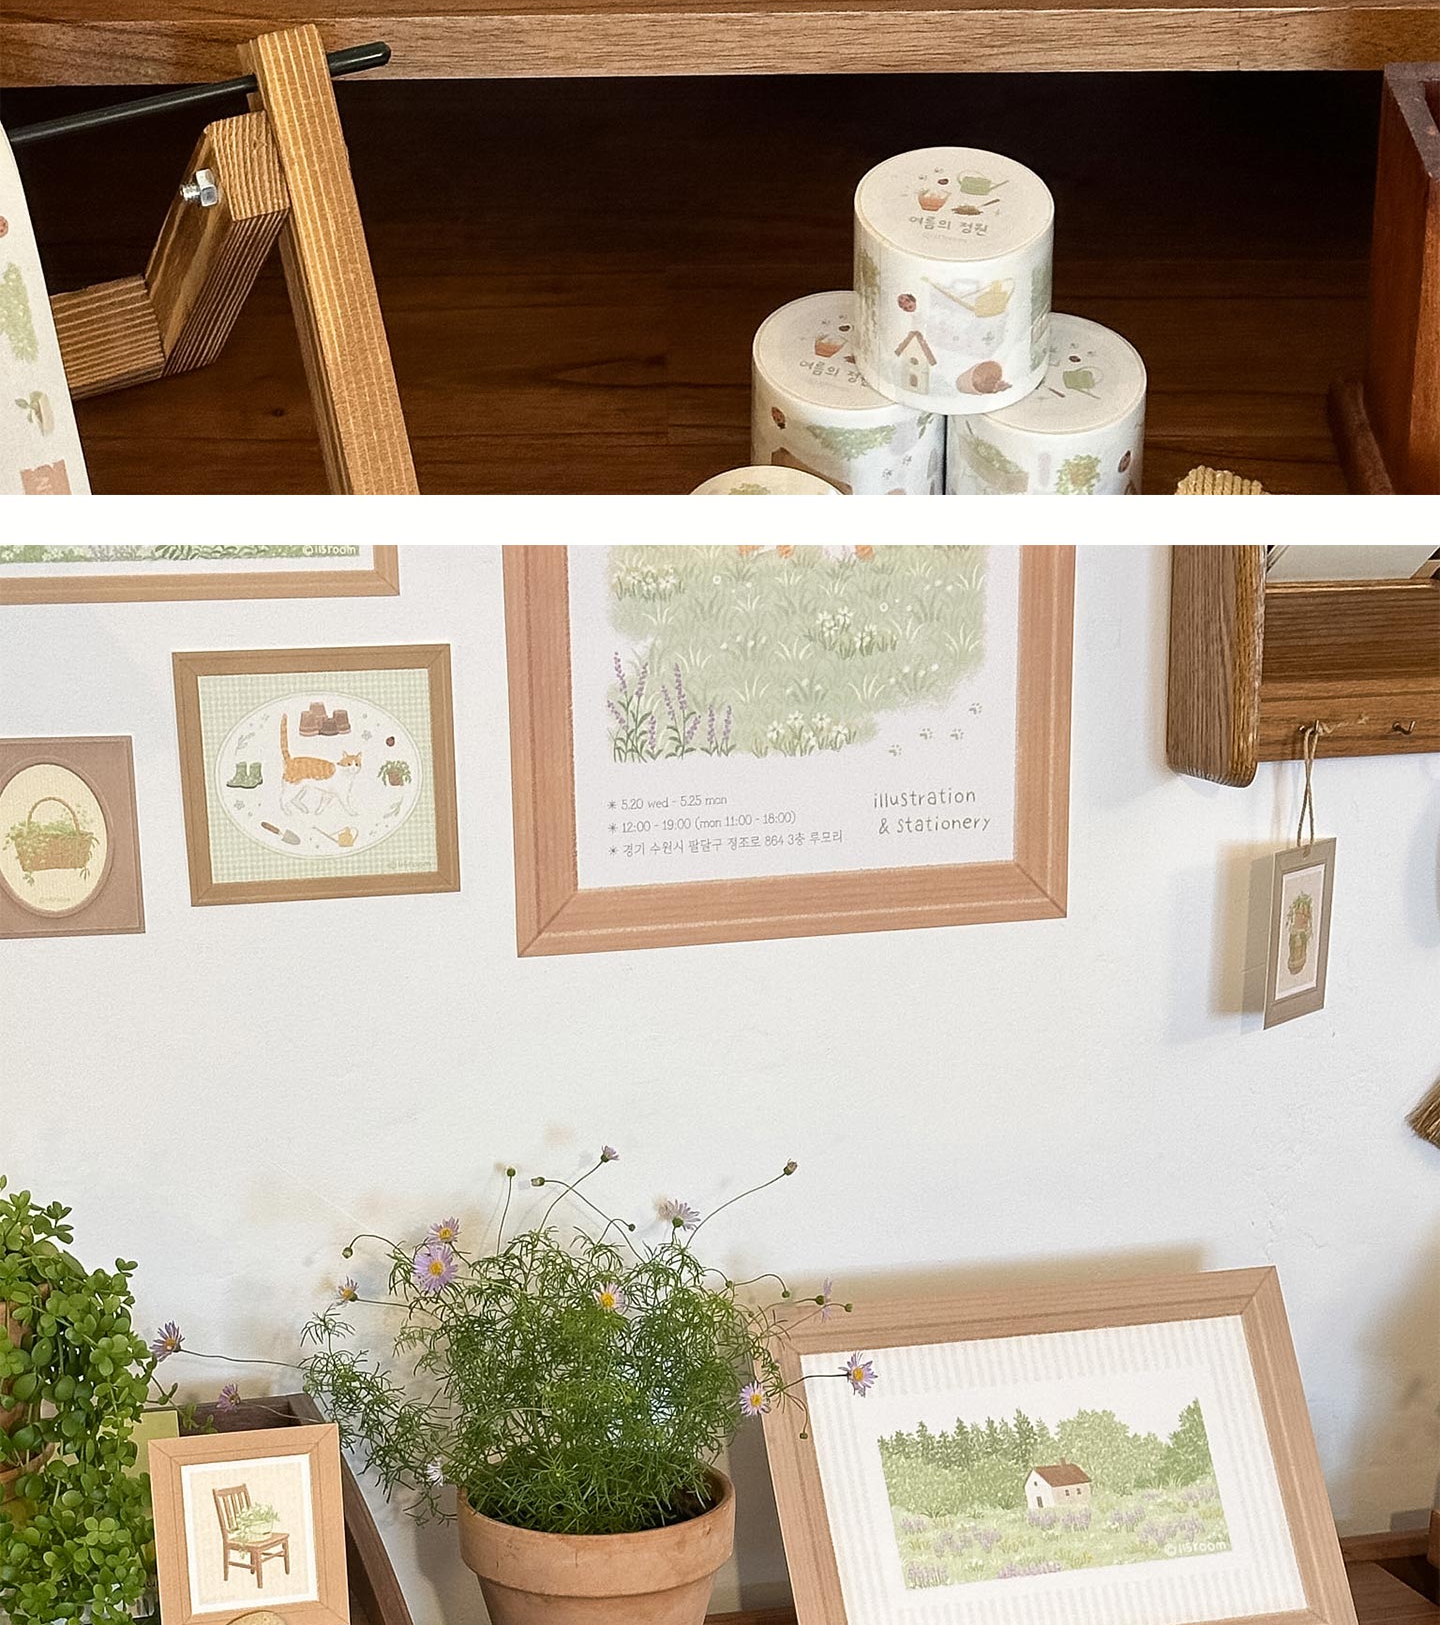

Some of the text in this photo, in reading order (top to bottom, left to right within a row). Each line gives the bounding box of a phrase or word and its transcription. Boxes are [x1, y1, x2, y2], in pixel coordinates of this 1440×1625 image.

[909, 215, 988, 237] 여름의 정원
[800, 360, 841, 377] 여름의
[621, 798, 644, 811] 5.20
[647, 796, 669, 809] wed
[705, 796, 728, 806] mon
[874, 787, 976, 808] illustration
[621, 820, 651, 834] 12:00
[662, 817, 691, 831] 19:00
[695, 816, 722, 831] (mon
[726, 814, 752, 827] 11:00
[763, 810, 797, 825] 18:00)
[878, 817, 890, 835] &
[623, 843, 645, 858] 경기
[650, 839, 684, 855] 수원시
[688, 838, 723, 854] 팔달구
[727, 835, 762, 851] 정조로
